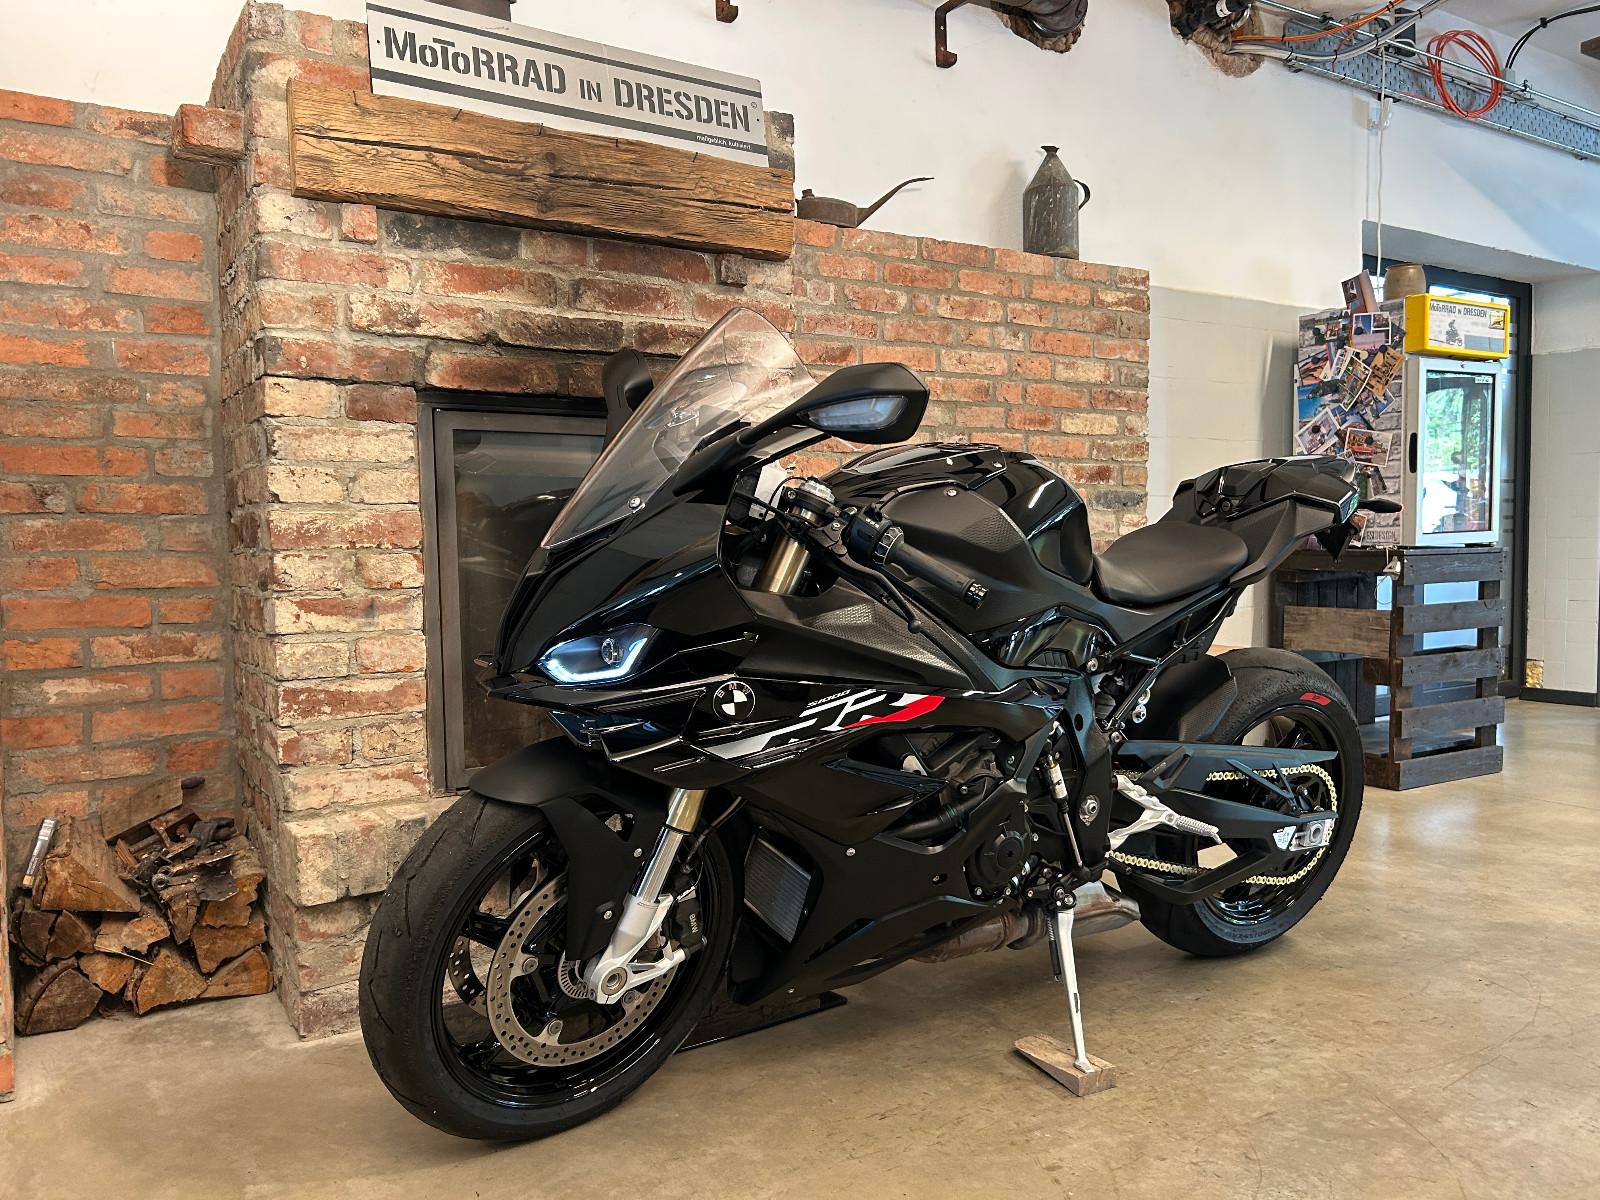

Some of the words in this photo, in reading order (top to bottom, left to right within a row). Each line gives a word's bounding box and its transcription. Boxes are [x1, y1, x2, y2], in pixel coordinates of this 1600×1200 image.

[579, 78, 602, 102] IN
[1463, 307, 1488, 318] DRESDEN
[689, 913, 698, 933] BMW
